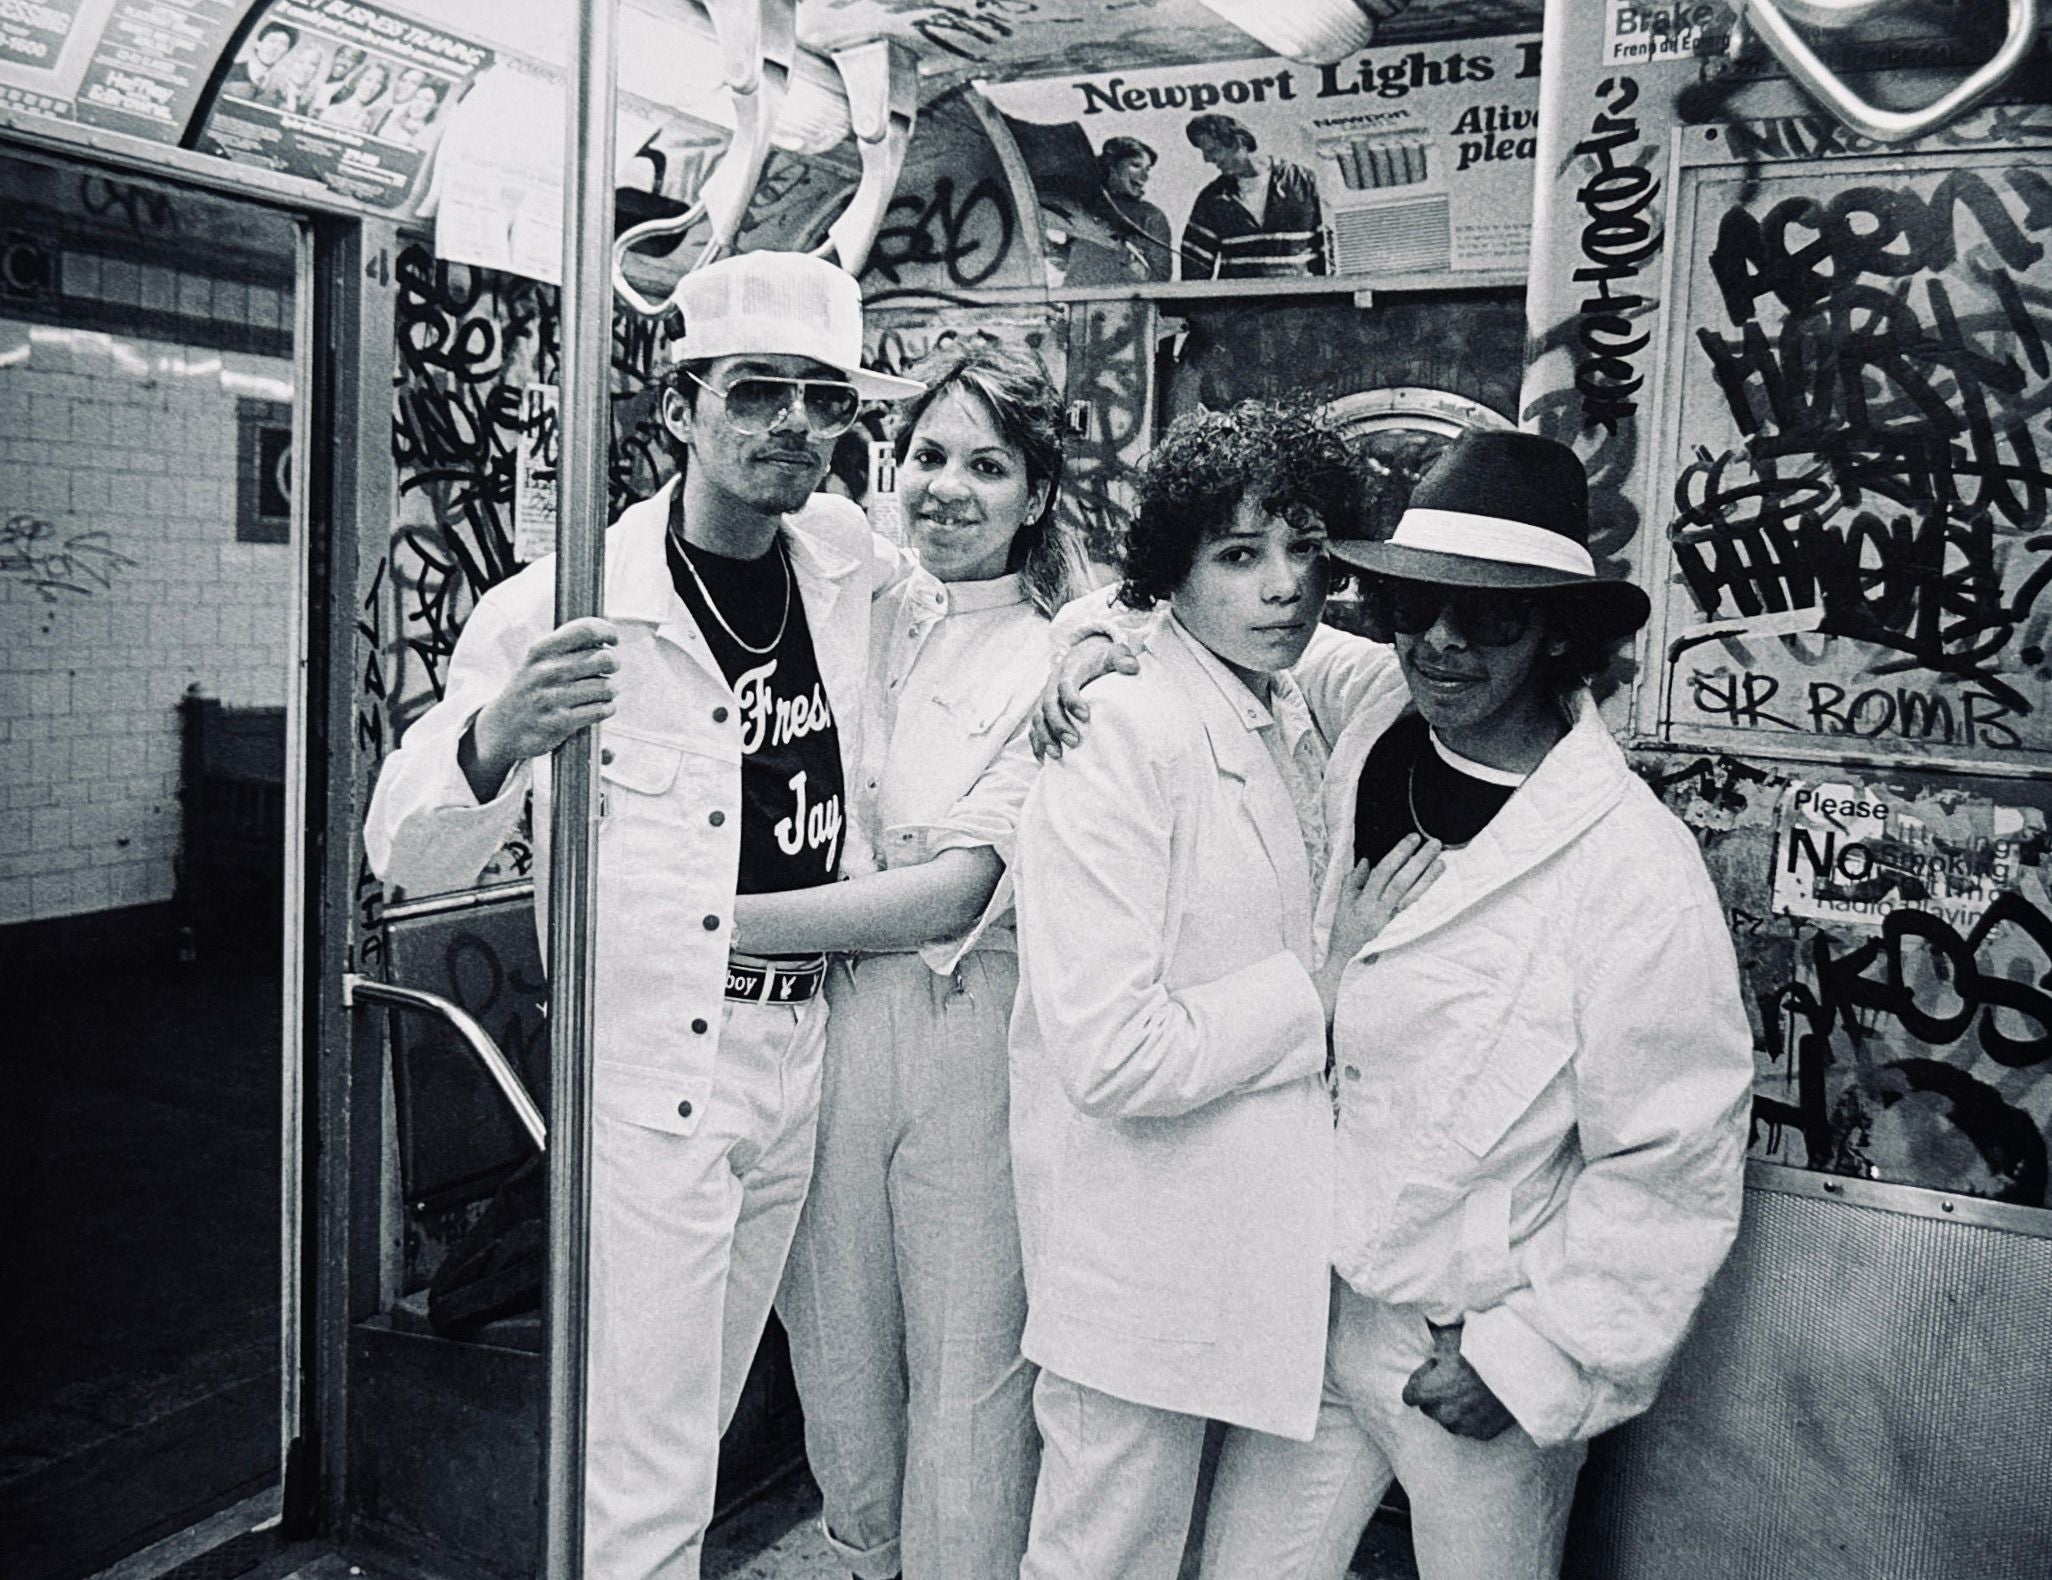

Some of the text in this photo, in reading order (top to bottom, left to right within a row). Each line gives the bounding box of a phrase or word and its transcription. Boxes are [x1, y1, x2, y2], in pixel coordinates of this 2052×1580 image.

[1615, 2, 1713, 36] Brake
[1073, 68, 1296, 114] Newport
[1315, 52, 1495, 98] Lights
[733, 659, 831, 754] Fres
[774, 770, 842, 873] Jay
[1794, 789, 1889, 820] Please
[1787, 826, 1874, 881] No
